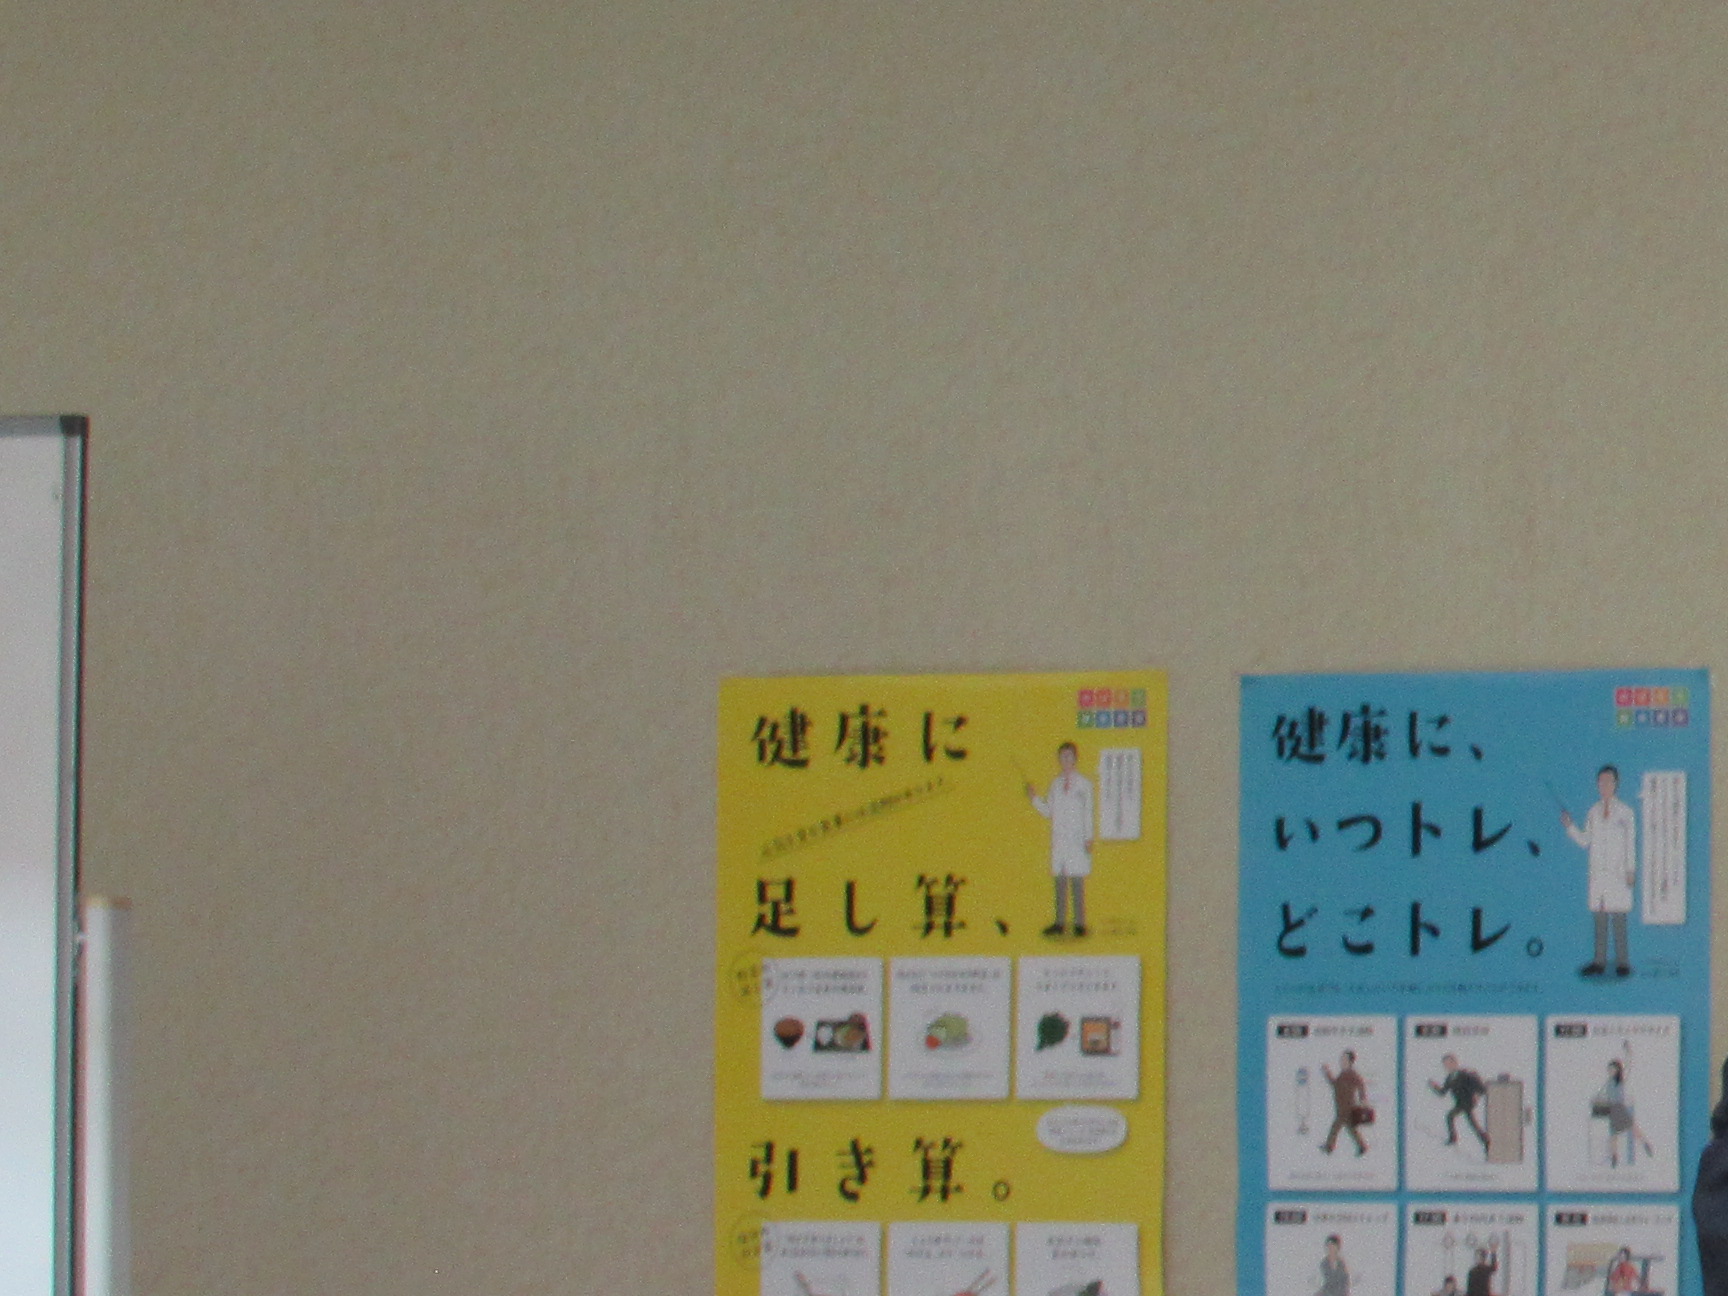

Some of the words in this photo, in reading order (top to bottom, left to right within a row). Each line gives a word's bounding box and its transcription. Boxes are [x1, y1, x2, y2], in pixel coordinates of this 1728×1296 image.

[751, 704, 969, 770] 健康に
[1272, 703, 1484, 765] 健康に、
[1274, 801, 1541, 857] いつトレ、
[751, 873, 1010, 938] 足し算、
[1277, 901, 1544, 958] どこトレ。
[749, 1138, 1011, 1203] 引き算。
